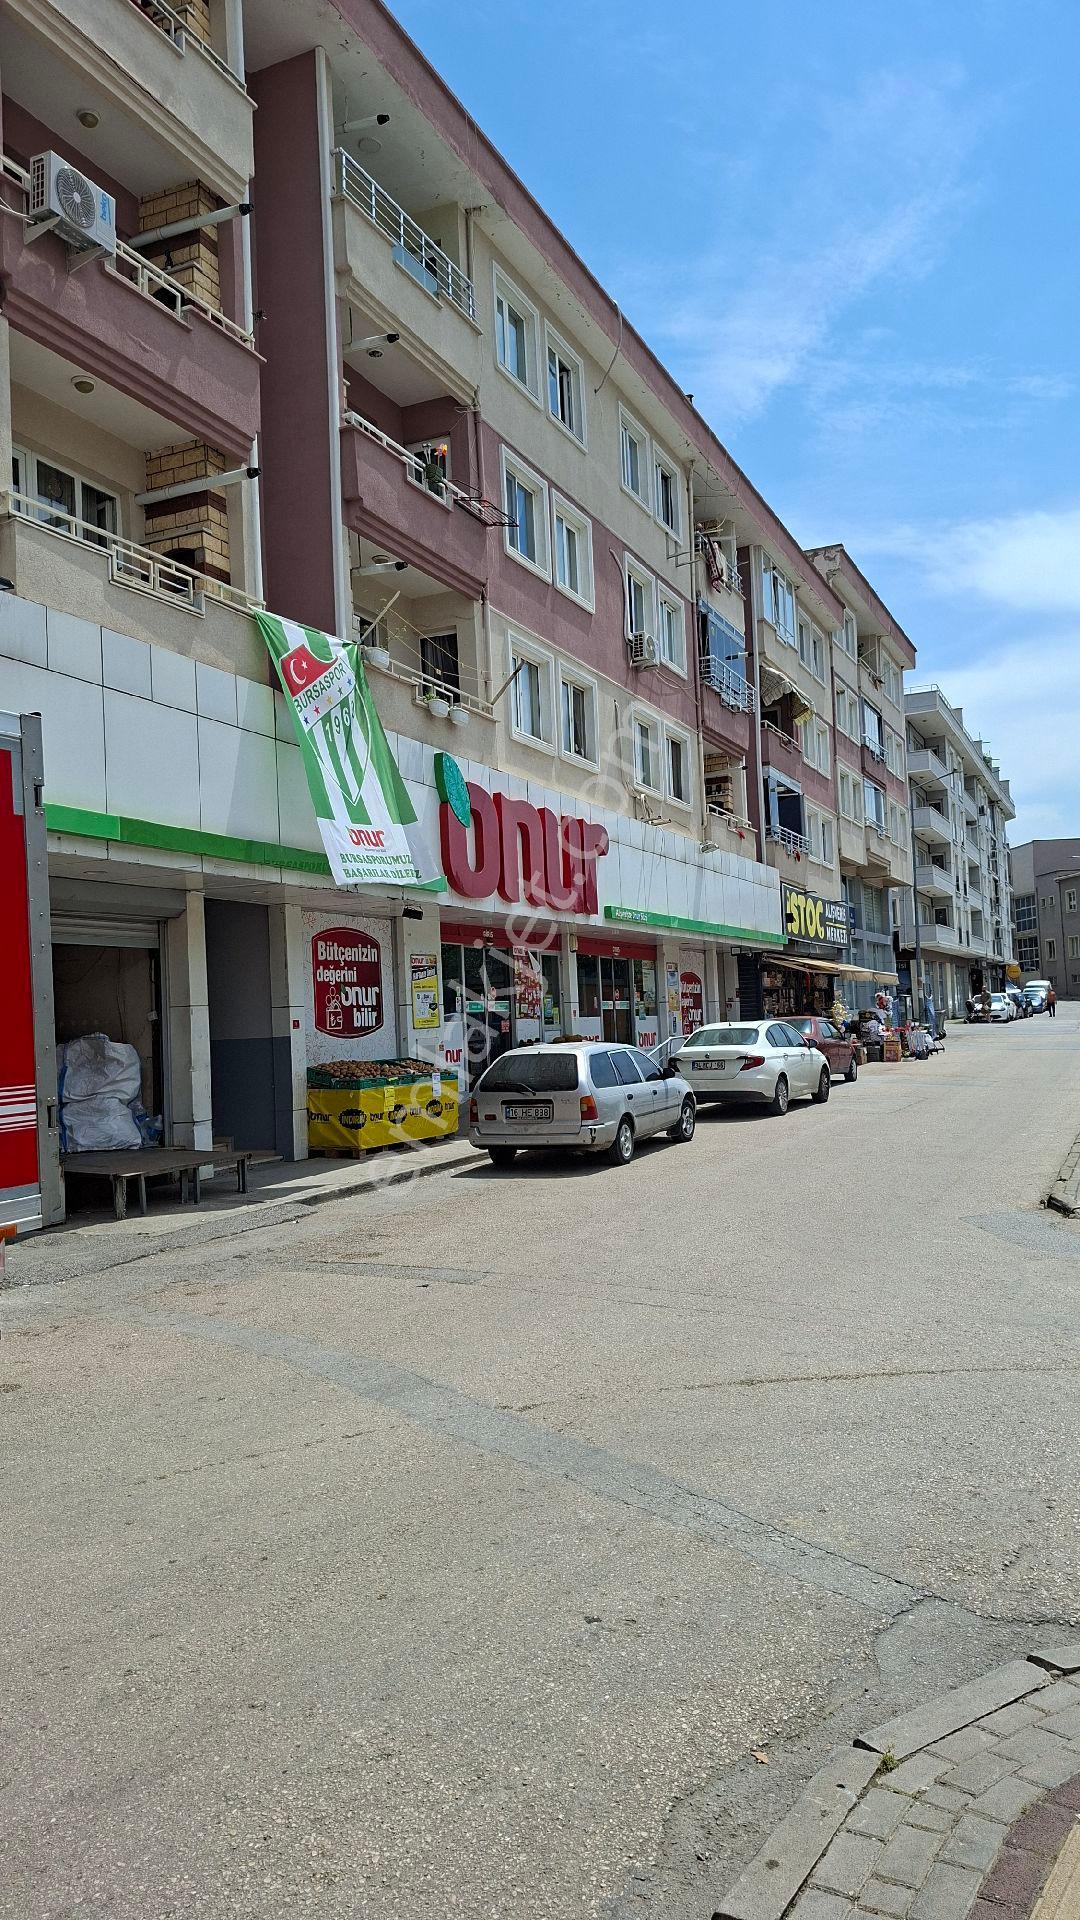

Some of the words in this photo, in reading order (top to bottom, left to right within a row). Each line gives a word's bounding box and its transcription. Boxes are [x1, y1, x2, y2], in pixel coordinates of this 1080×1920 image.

[293, 662, 347, 714] BURSASPOR
[349, 828, 385, 848] onur
[340, 853, 413, 866] BURSASPORUMUZ
[343, 868, 390, 880] BAŞARILAR
[317, 940, 378, 966] Bütçenizin
[316, 965, 357, 985] değerini
[341, 986, 380, 1006] onur
[353, 1008, 377, 1027] bilir
[638, 1031, 657, 1047] onur
[510, 1108, 519, 1117] 16
